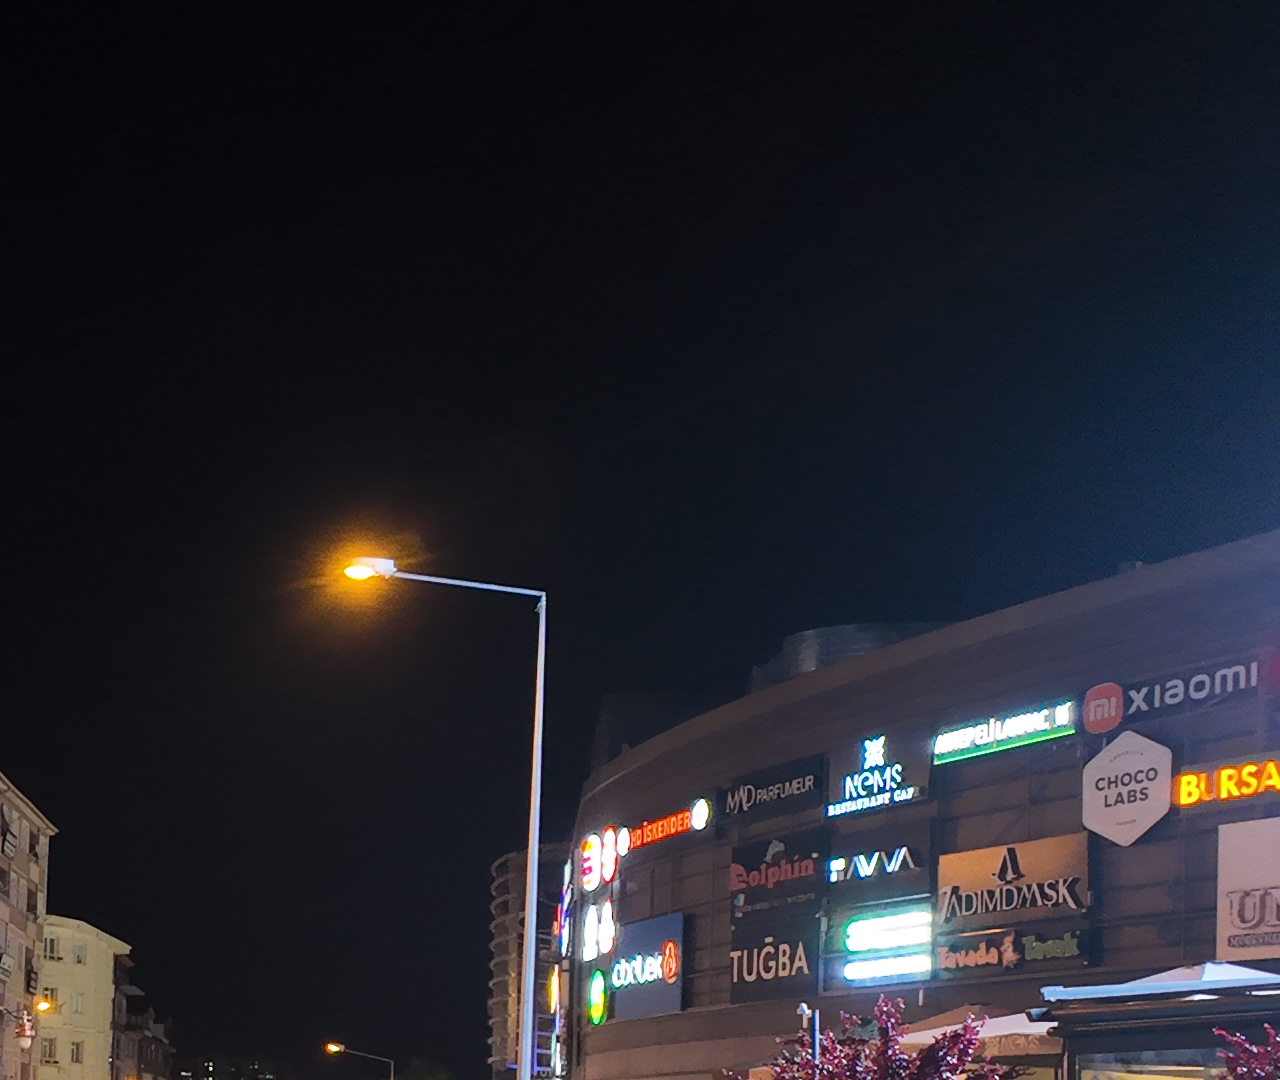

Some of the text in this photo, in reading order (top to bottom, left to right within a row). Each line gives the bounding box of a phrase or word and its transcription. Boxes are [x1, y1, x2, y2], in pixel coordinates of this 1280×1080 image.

[756, 775, 814, 804] PARFUMEUR
[1095, 767, 1159, 792] CHOCO
[1104, 786, 1149, 808] LABS
[729, 854, 816, 891] Dolphin
[730, 937, 809, 982] TUĞBA
